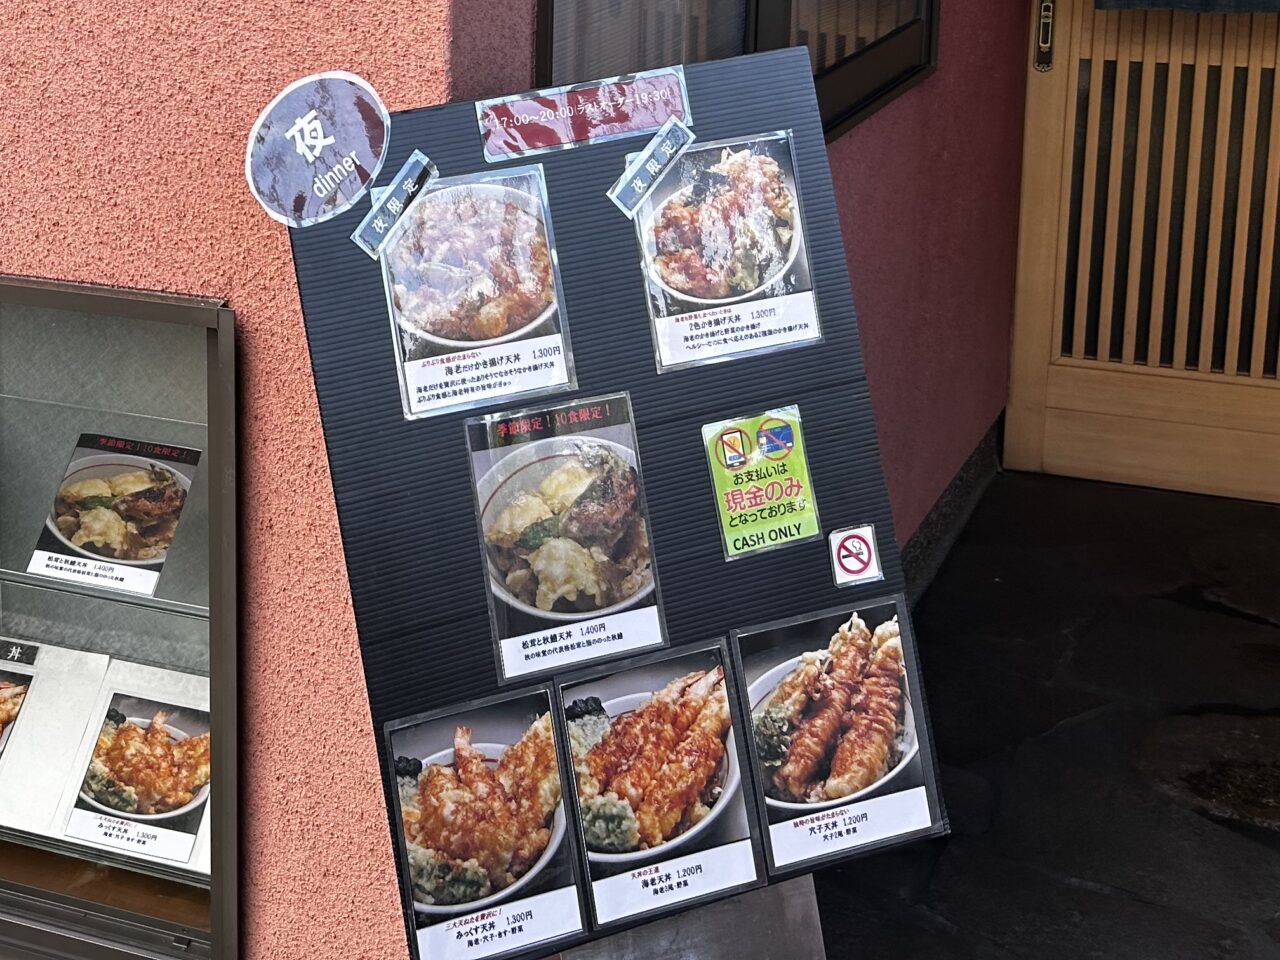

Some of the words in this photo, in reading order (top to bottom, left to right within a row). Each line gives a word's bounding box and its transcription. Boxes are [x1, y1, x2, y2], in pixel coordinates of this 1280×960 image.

[284, 109, 335, 163] 夜
[312, 150, 361, 198] dinner
[631, 143, 676, 193] 夜限定
[372, 178, 418, 234] 夜限定
[445, 353, 521, 376] 海老だけかき揚げ天丼
[733, 462, 789, 486] お支払いは
[723, 476, 803, 513] 現金のみ
[729, 498, 807, 528] となっております
[733, 532, 766, 551] CASH
[768, 523, 801, 542] ONLY
[809, 821, 838, 836] 穴子天丼
[641, 873, 672, 889] 海老天丼
[455, 921, 496, 940] みっくす天丼
